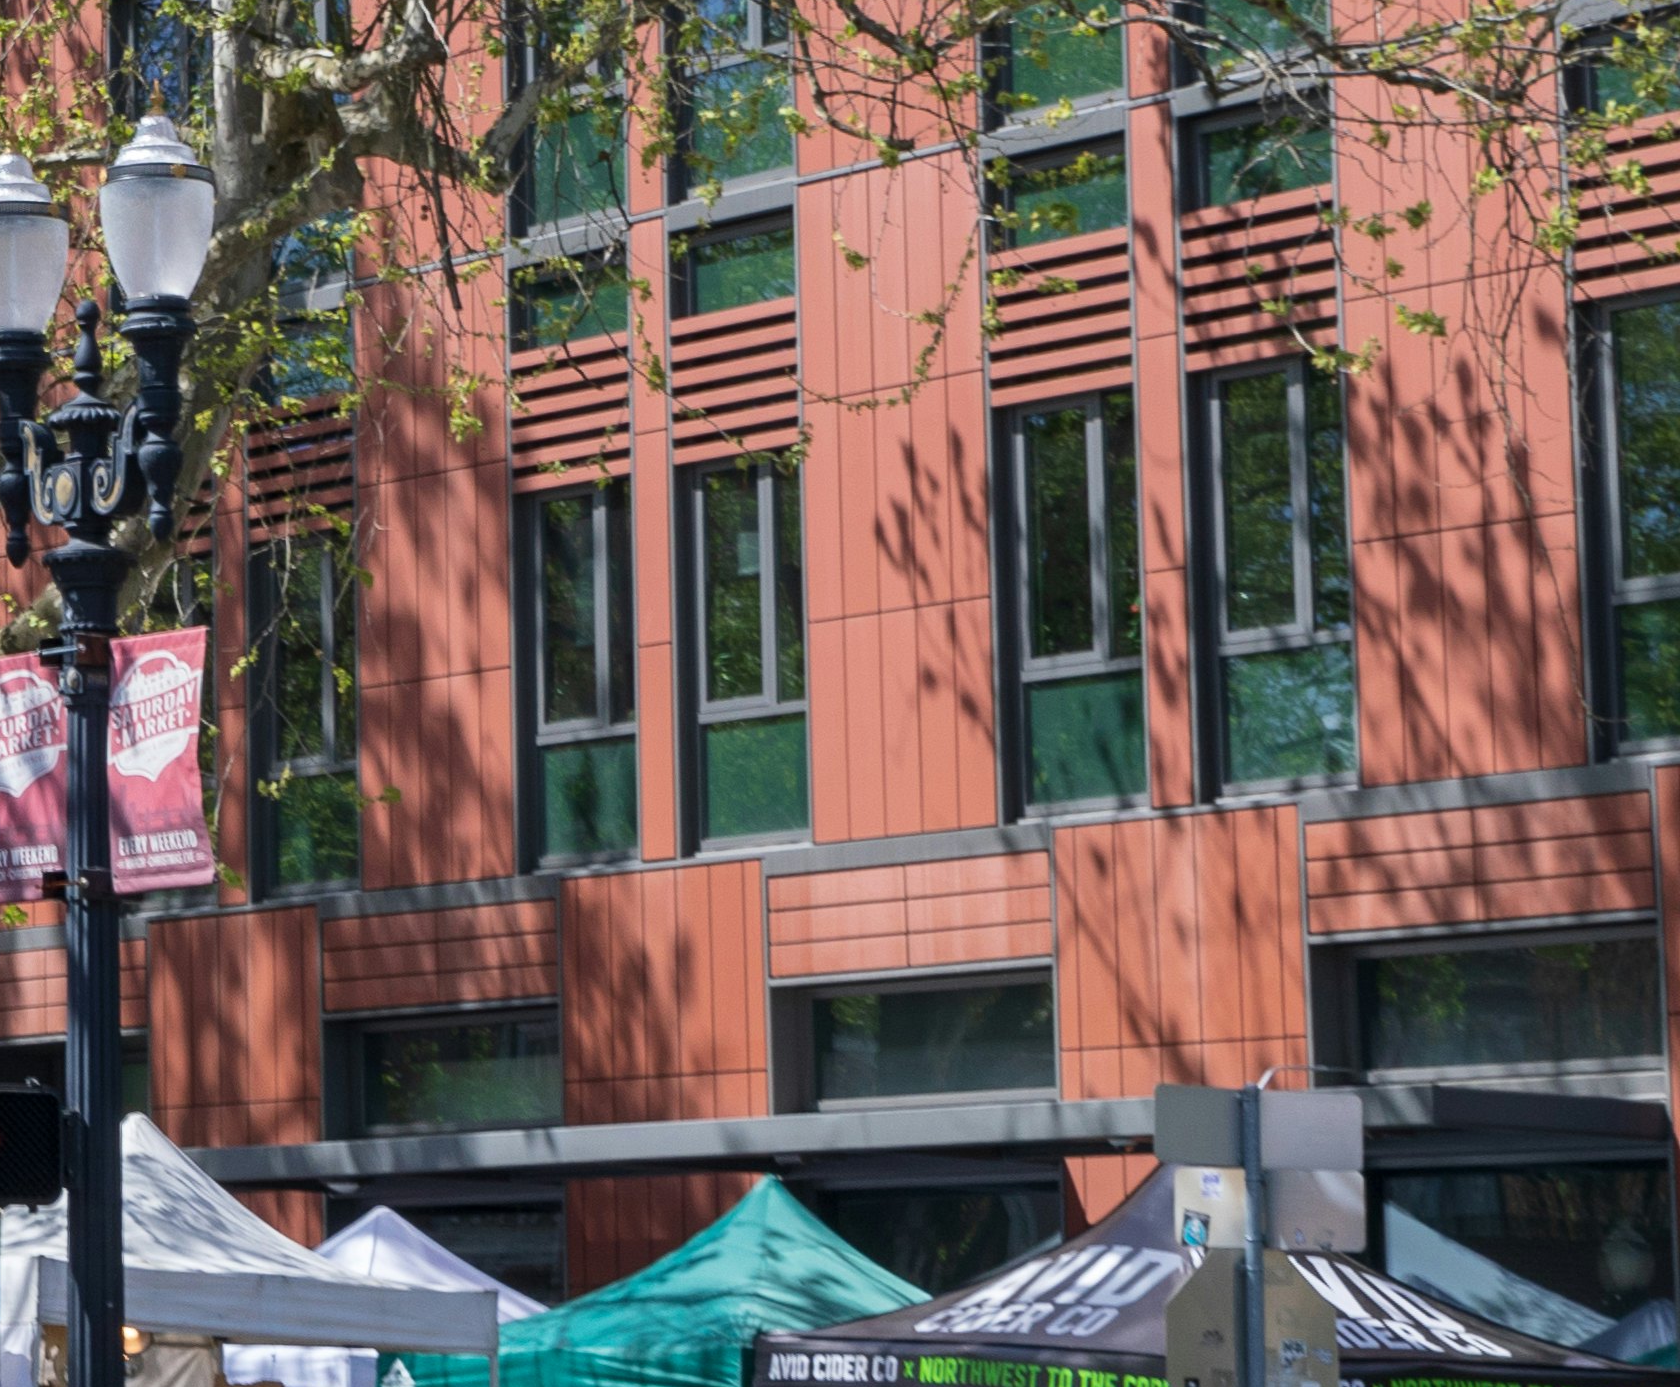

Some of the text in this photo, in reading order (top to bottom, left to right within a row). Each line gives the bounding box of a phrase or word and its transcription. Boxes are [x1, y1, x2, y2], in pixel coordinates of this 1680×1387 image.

[110, 681, 197, 730] SATURDAY
[121, 709, 187, 749] MARKET
[10, 844, 59, 865] WEEKEND
[118, 829, 198, 856] EVERY WEEKEND
[960, 1244, 1184, 1308] AVID
[1287, 1254, 1466, 1334] VID
[914, 1301, 1120, 1337] CIDER CO
[1430, 1327, 1513, 1358] CO
[768, 1353, 810, 1381] AVID
[812, 1353, 868, 1382] CIDER
[872, 1355, 899, 1383] CO
